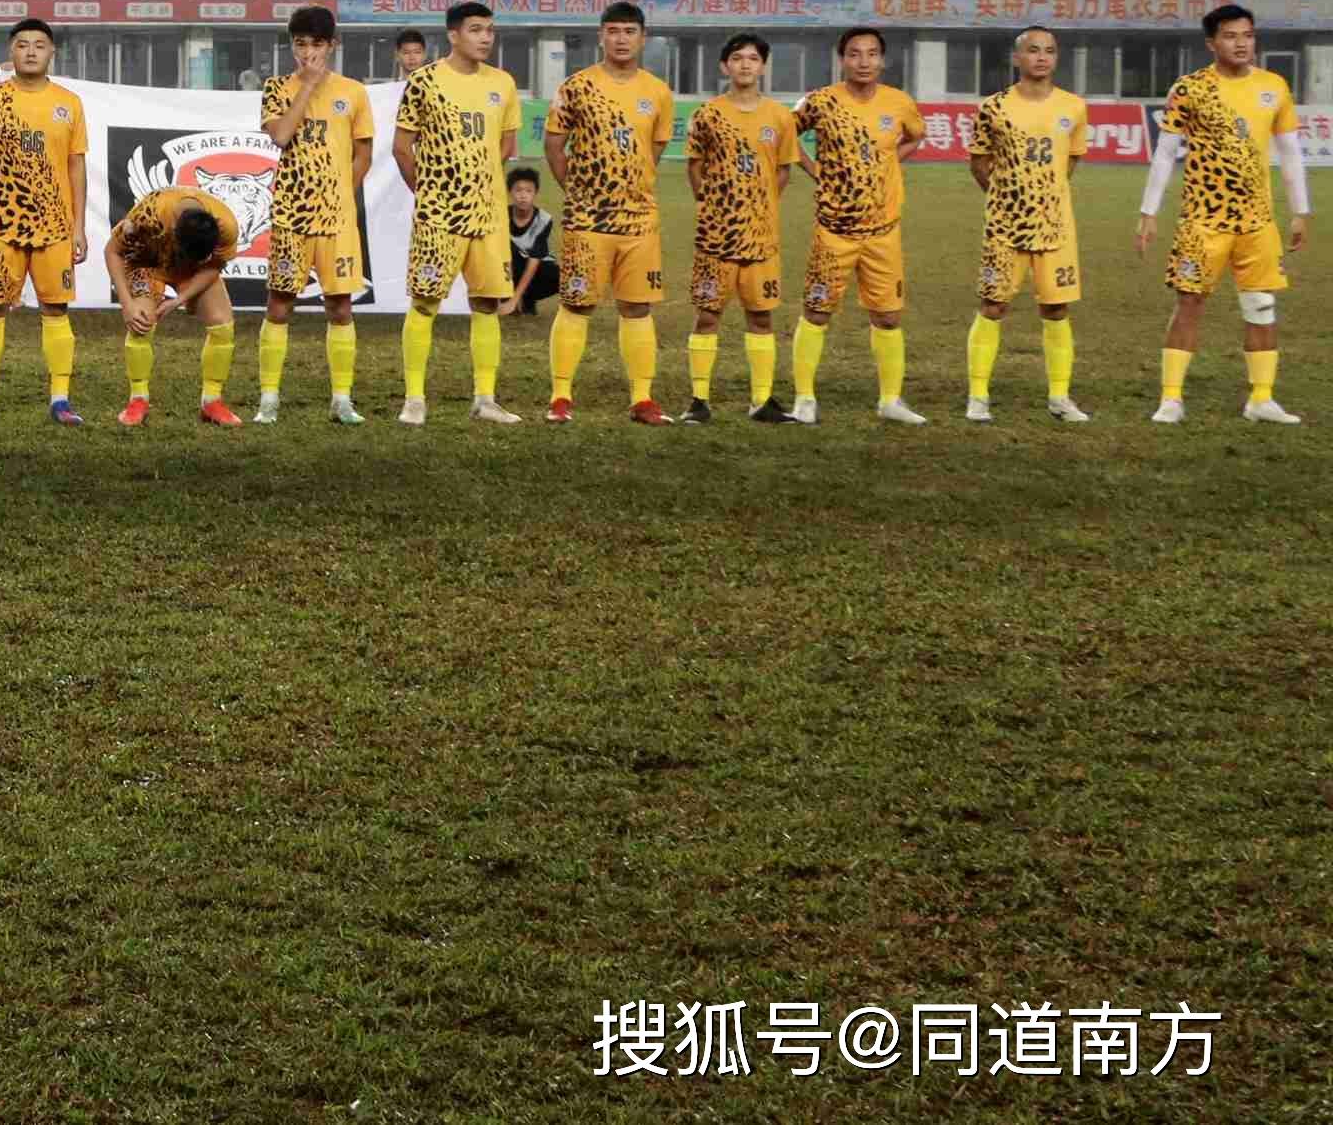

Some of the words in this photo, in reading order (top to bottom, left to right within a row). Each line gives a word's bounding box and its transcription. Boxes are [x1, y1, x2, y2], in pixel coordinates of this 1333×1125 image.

[173, 140, 197, 156] WE
[200, 137, 228, 149] ARE
[232, 136, 241, 147] A
[1025, 136, 1052, 164] 22
[1055, 265, 1077, 288] 22
